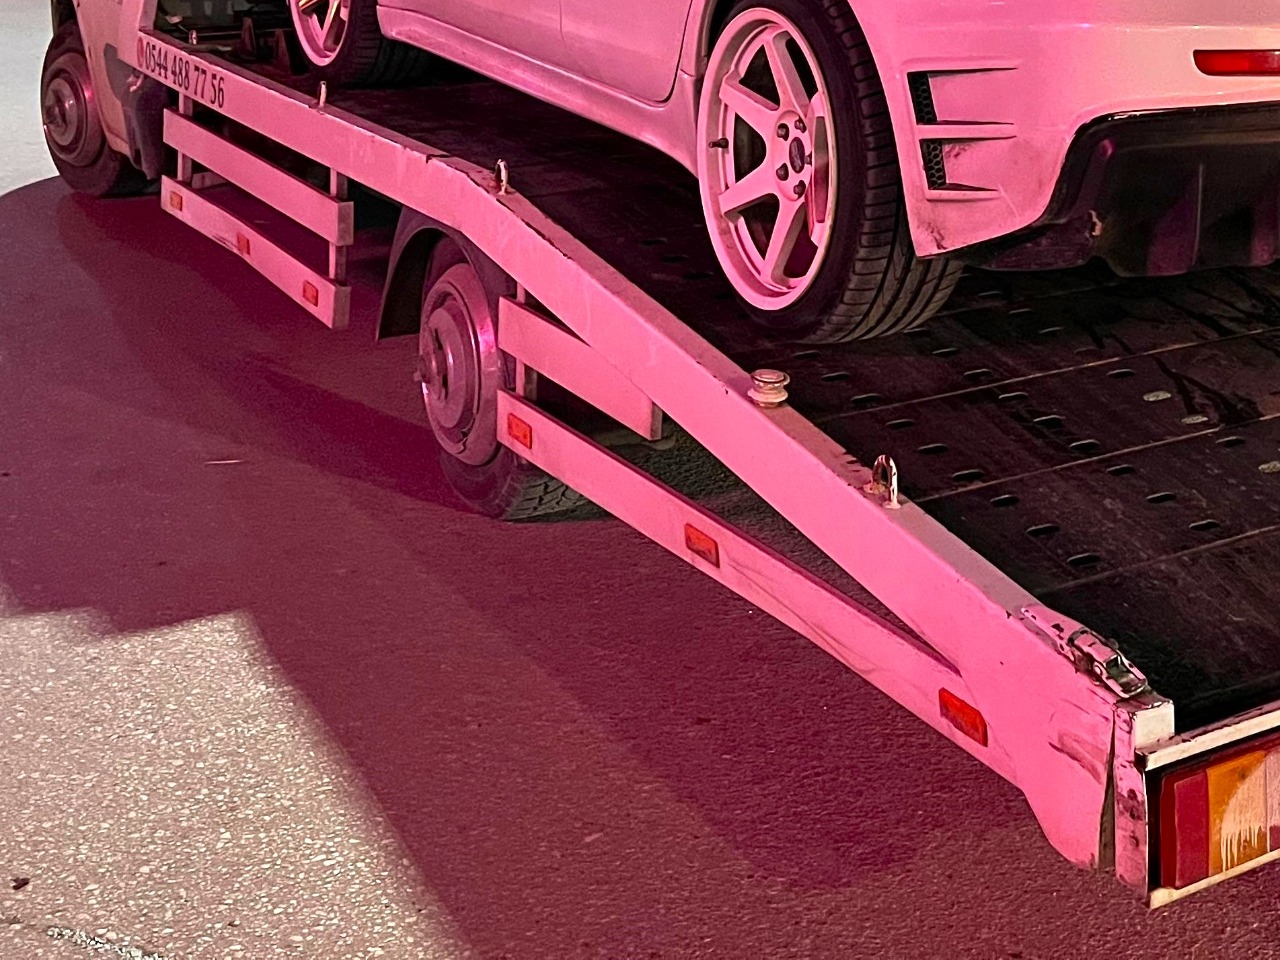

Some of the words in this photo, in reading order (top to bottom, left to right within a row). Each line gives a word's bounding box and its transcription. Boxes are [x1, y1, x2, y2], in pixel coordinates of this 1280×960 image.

[145, 41, 168, 80] 0544
[171, 54, 190, 92] 488
[194, 64, 207, 100] 77
[210, 73, 225, 109] 56
